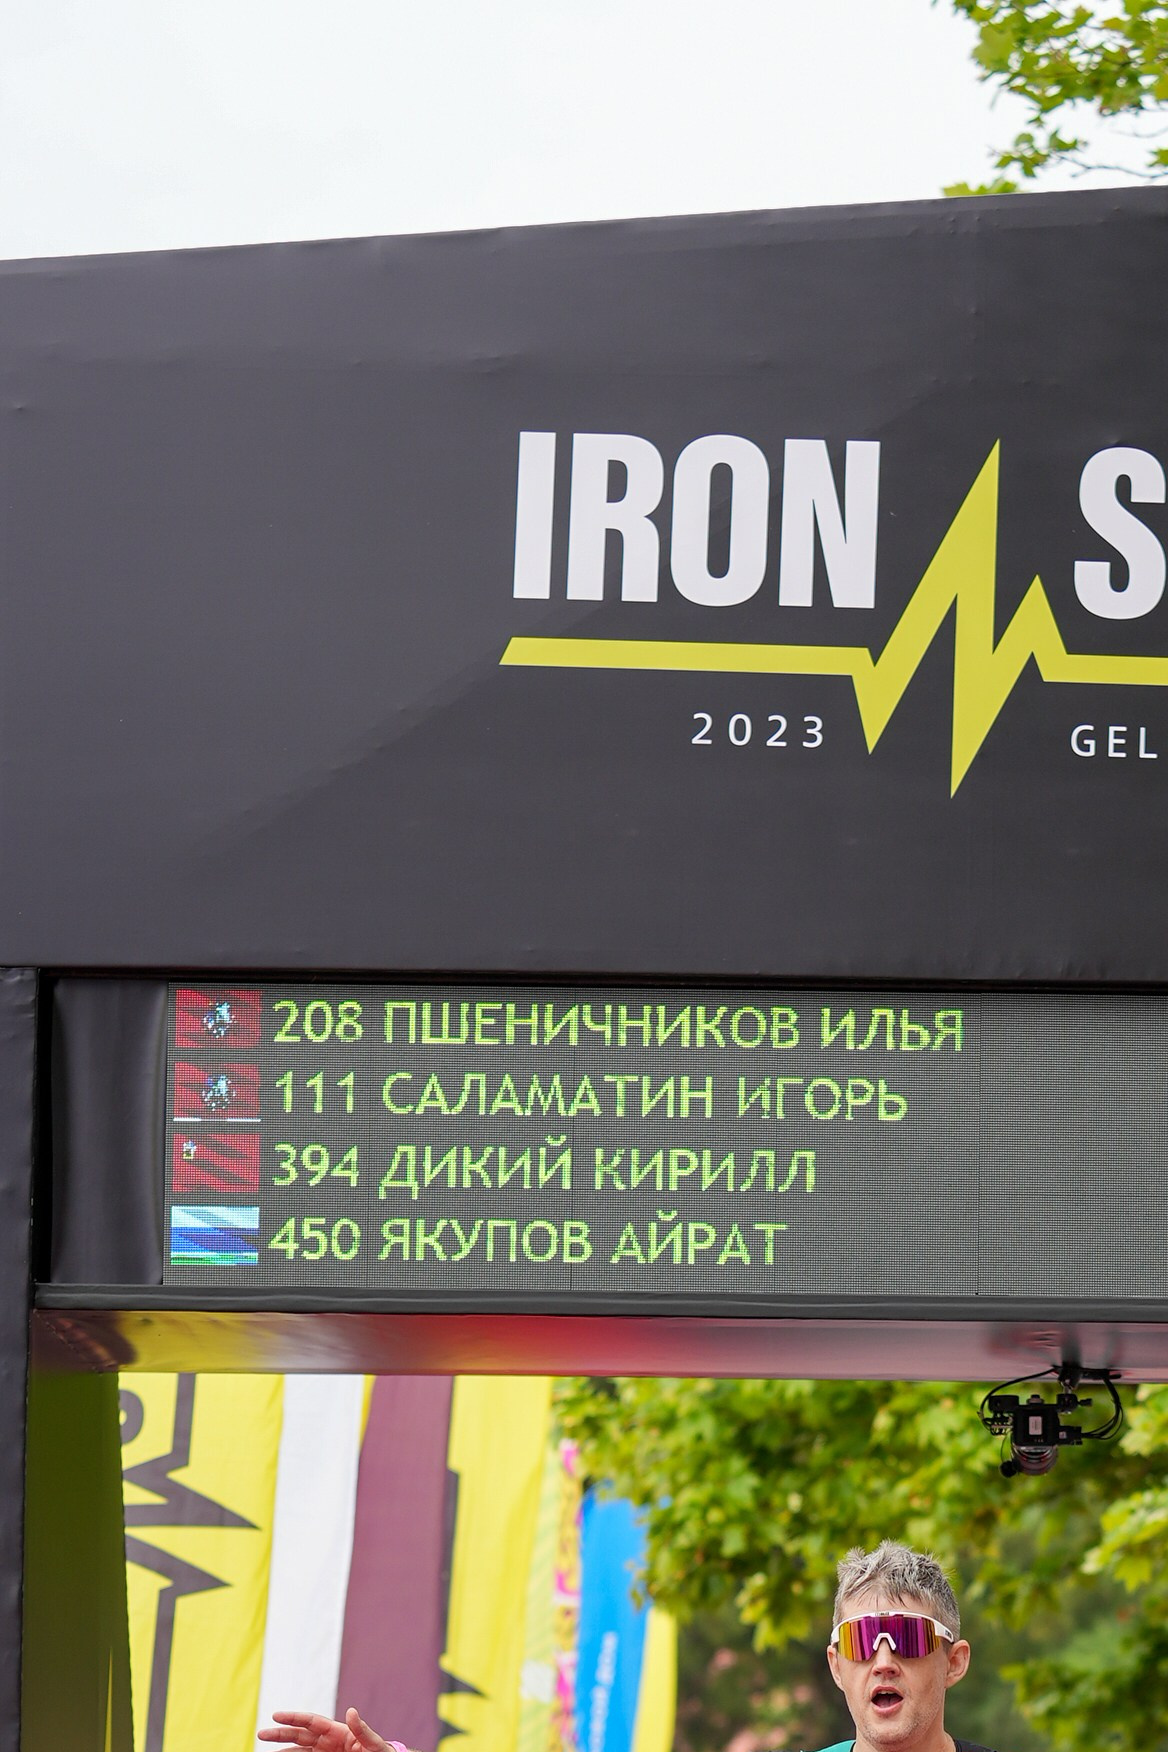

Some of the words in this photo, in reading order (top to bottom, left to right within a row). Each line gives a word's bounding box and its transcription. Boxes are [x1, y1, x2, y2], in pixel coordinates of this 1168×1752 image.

[513, 431, 880, 609] IRON
[690, 712, 826, 748] 2023
[273, 1001, 362, 1043] 208
[383, 1001, 798, 1049] ПШЕНИЧНИКОВ
[819, 1007, 964, 1052] ИЛЬЯ
[275, 1072, 358, 1114] 111
[382, 1072, 713, 1118] САЛАМАТИН
[738, 1076, 908, 1122] ИГОРЬ
[273, 1145, 360, 1188] 394
[379, 1136, 572, 1200] ДИКИЙ
[596, 1147, 817, 1194] КИРИЛЛ
[269, 1218, 361, 1262] 450
[380, 1219, 592, 1265] ЯКУПОВ
[610, 1210, 789, 1265] АЙРАТ
